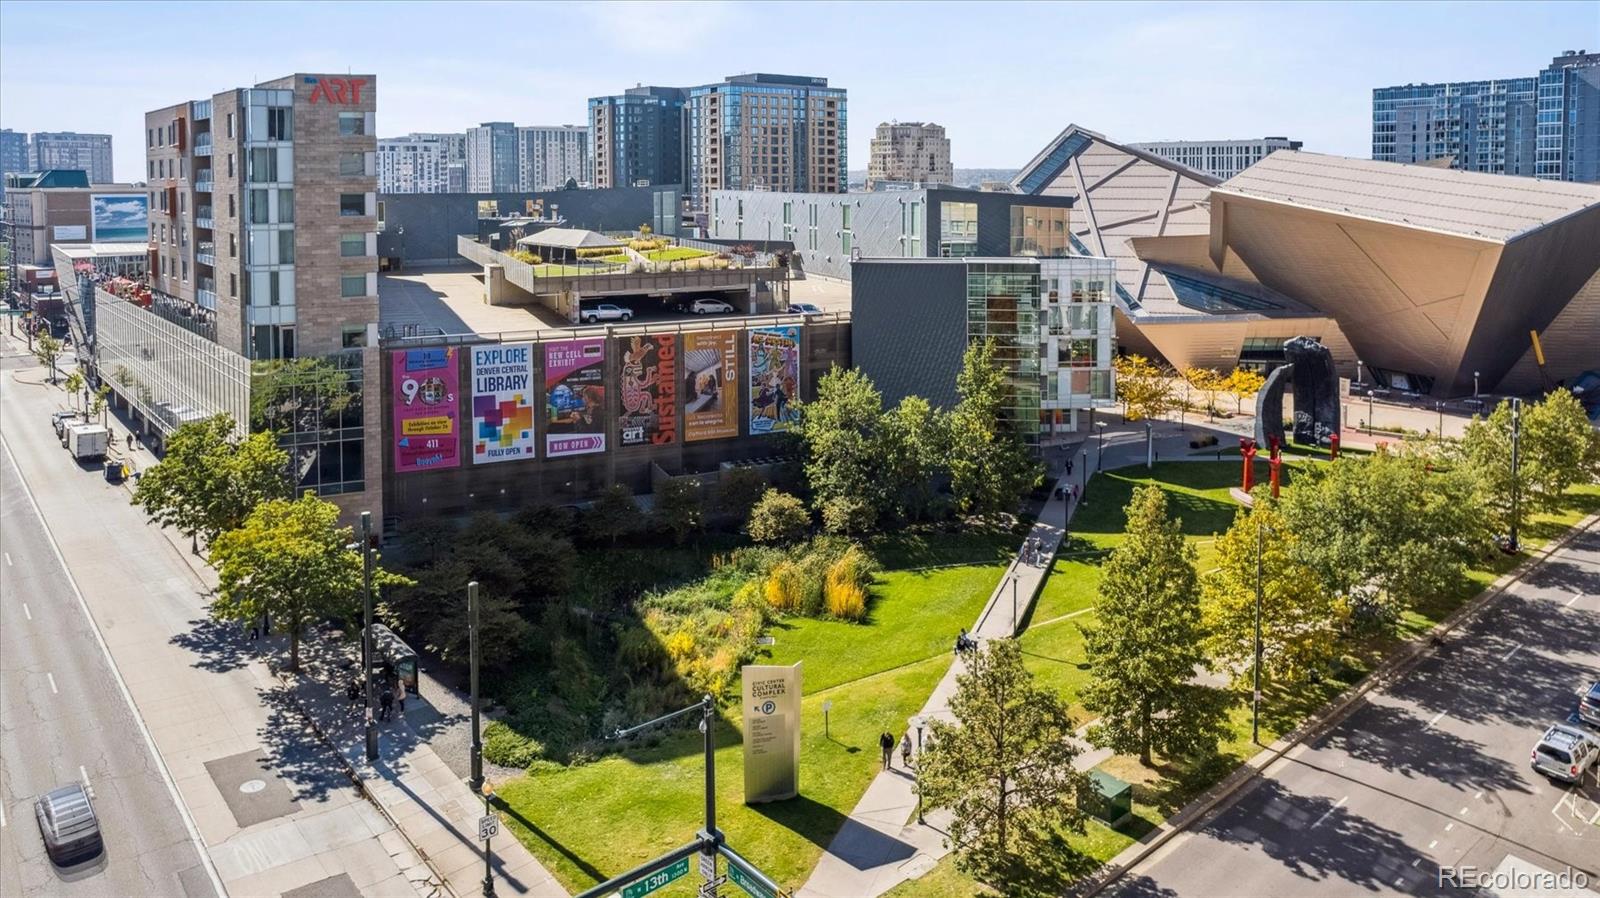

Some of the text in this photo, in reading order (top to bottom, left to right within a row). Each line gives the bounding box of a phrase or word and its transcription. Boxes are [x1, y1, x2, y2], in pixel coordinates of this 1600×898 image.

[310, 78, 367, 105] ART
[476, 348, 528, 366] EXPLORE
[565, 350, 582, 359] CELL
[725, 334, 735, 381] STILL
[549, 358, 575, 368] EXHIBIT
[476, 364, 528, 376] DENVER CENTRAL
[477, 374, 528, 393] LIBRARY
[622, 426, 644, 440] art
[426, 439, 439, 448] 411
[553, 440, 589, 451] NOW OPEN
[488, 447, 521, 457] FULLY OPEN
[752, 683, 785, 692] CULTURAL
[752, 689, 786, 698] COMPLEX
[765, 703, 773, 713] P
[481, 825, 497, 839] 30
[644, 872, 669, 892] 13th
